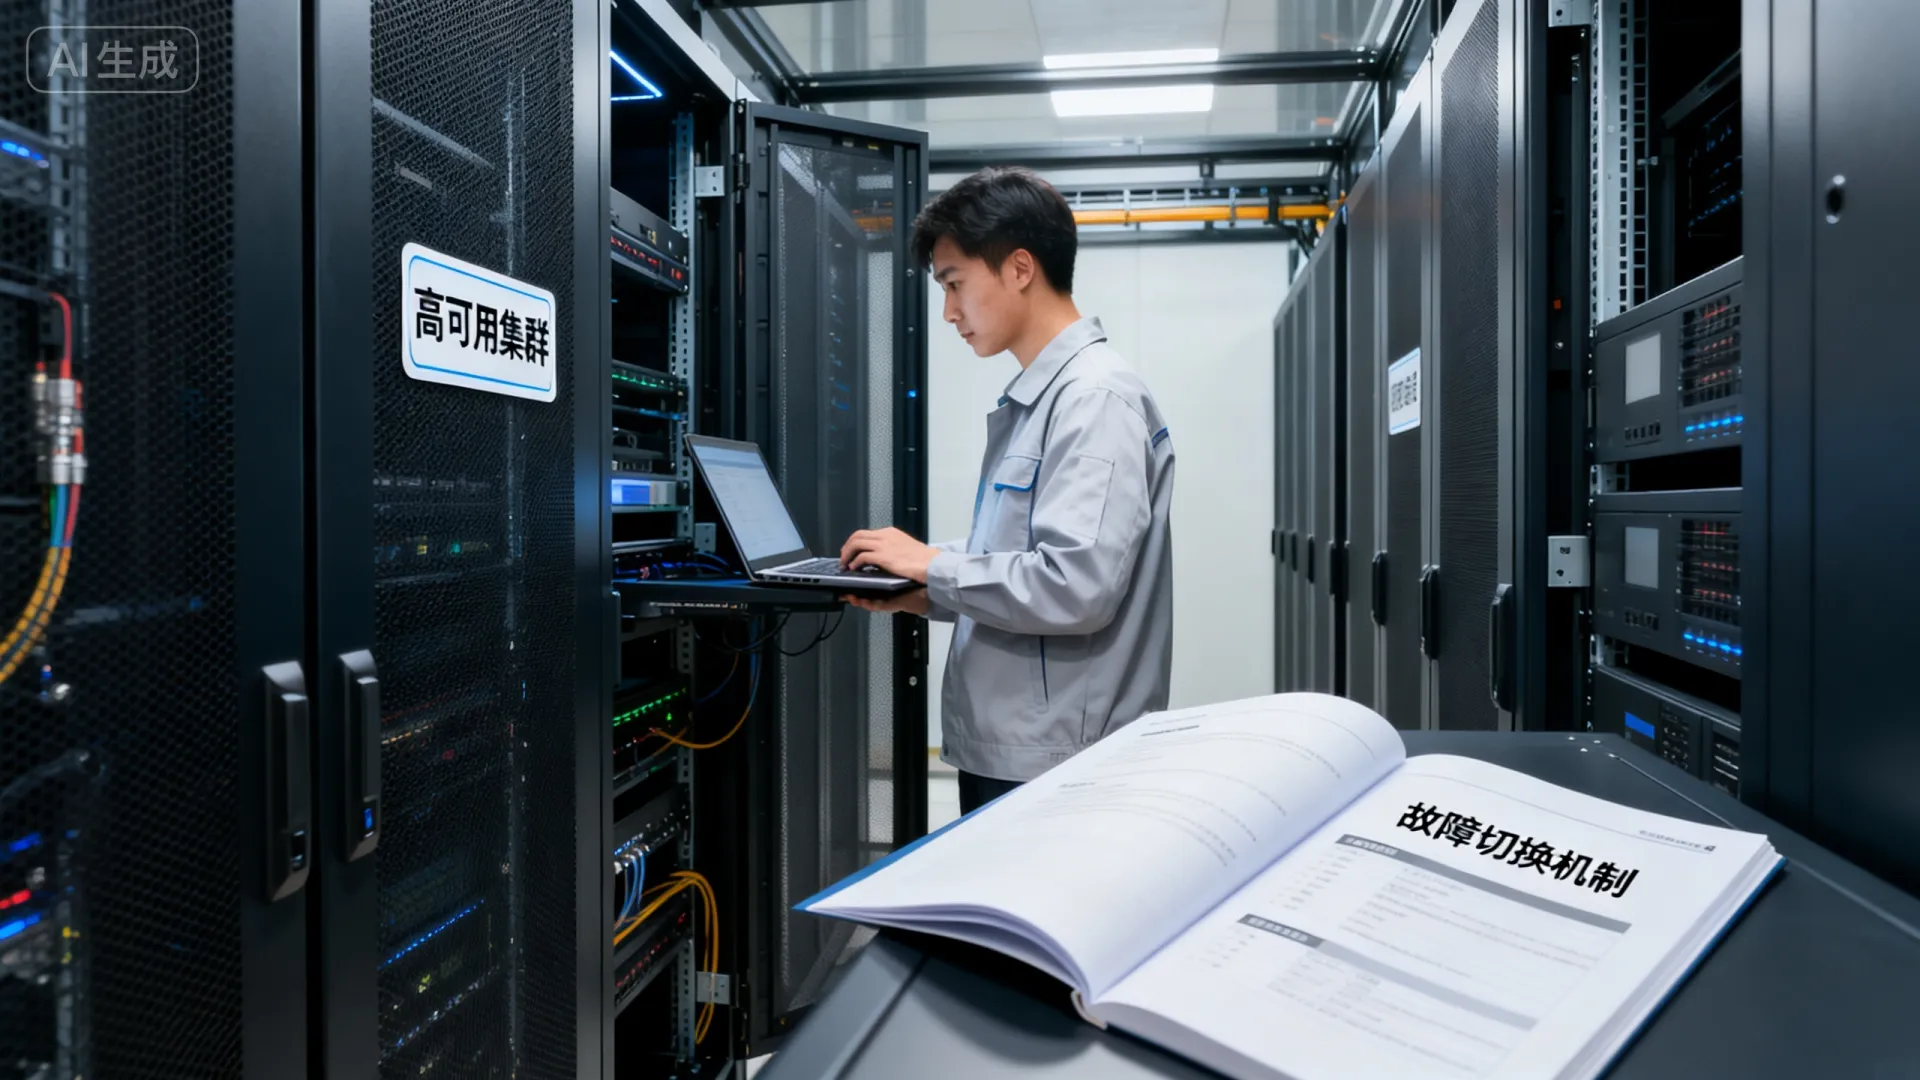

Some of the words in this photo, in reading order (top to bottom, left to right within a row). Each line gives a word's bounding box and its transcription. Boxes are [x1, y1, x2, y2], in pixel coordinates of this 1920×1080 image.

[414, 286, 549, 367] 高可用集群
[1396, 801, 1640, 898] 故障切换机制
